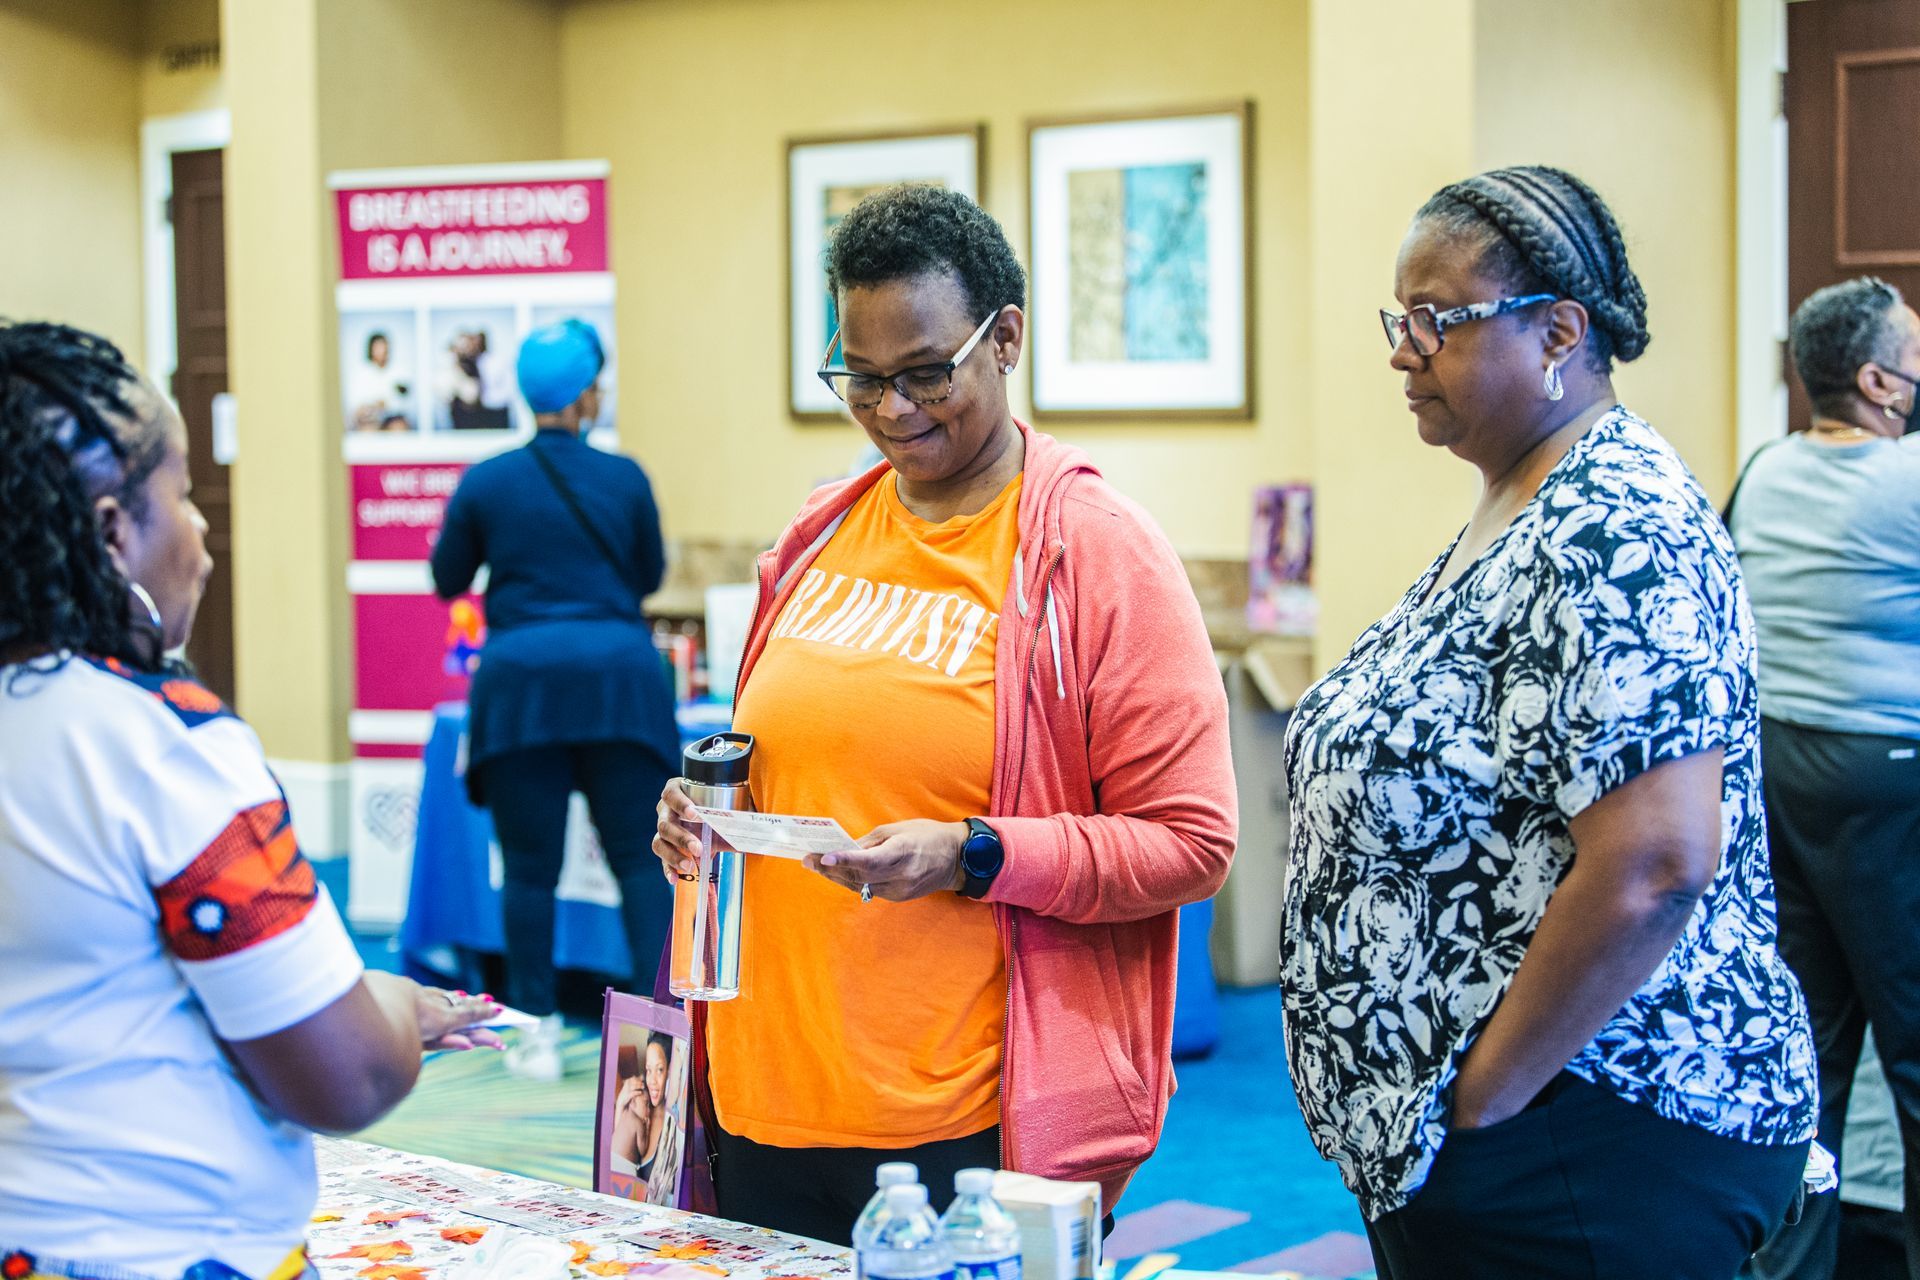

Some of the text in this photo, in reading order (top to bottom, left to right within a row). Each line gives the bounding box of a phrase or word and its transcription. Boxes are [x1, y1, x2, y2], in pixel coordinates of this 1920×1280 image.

[350, 185, 590, 231] BREASTFEEDING
[367, 228, 573, 273] IS A JOURNEY.
